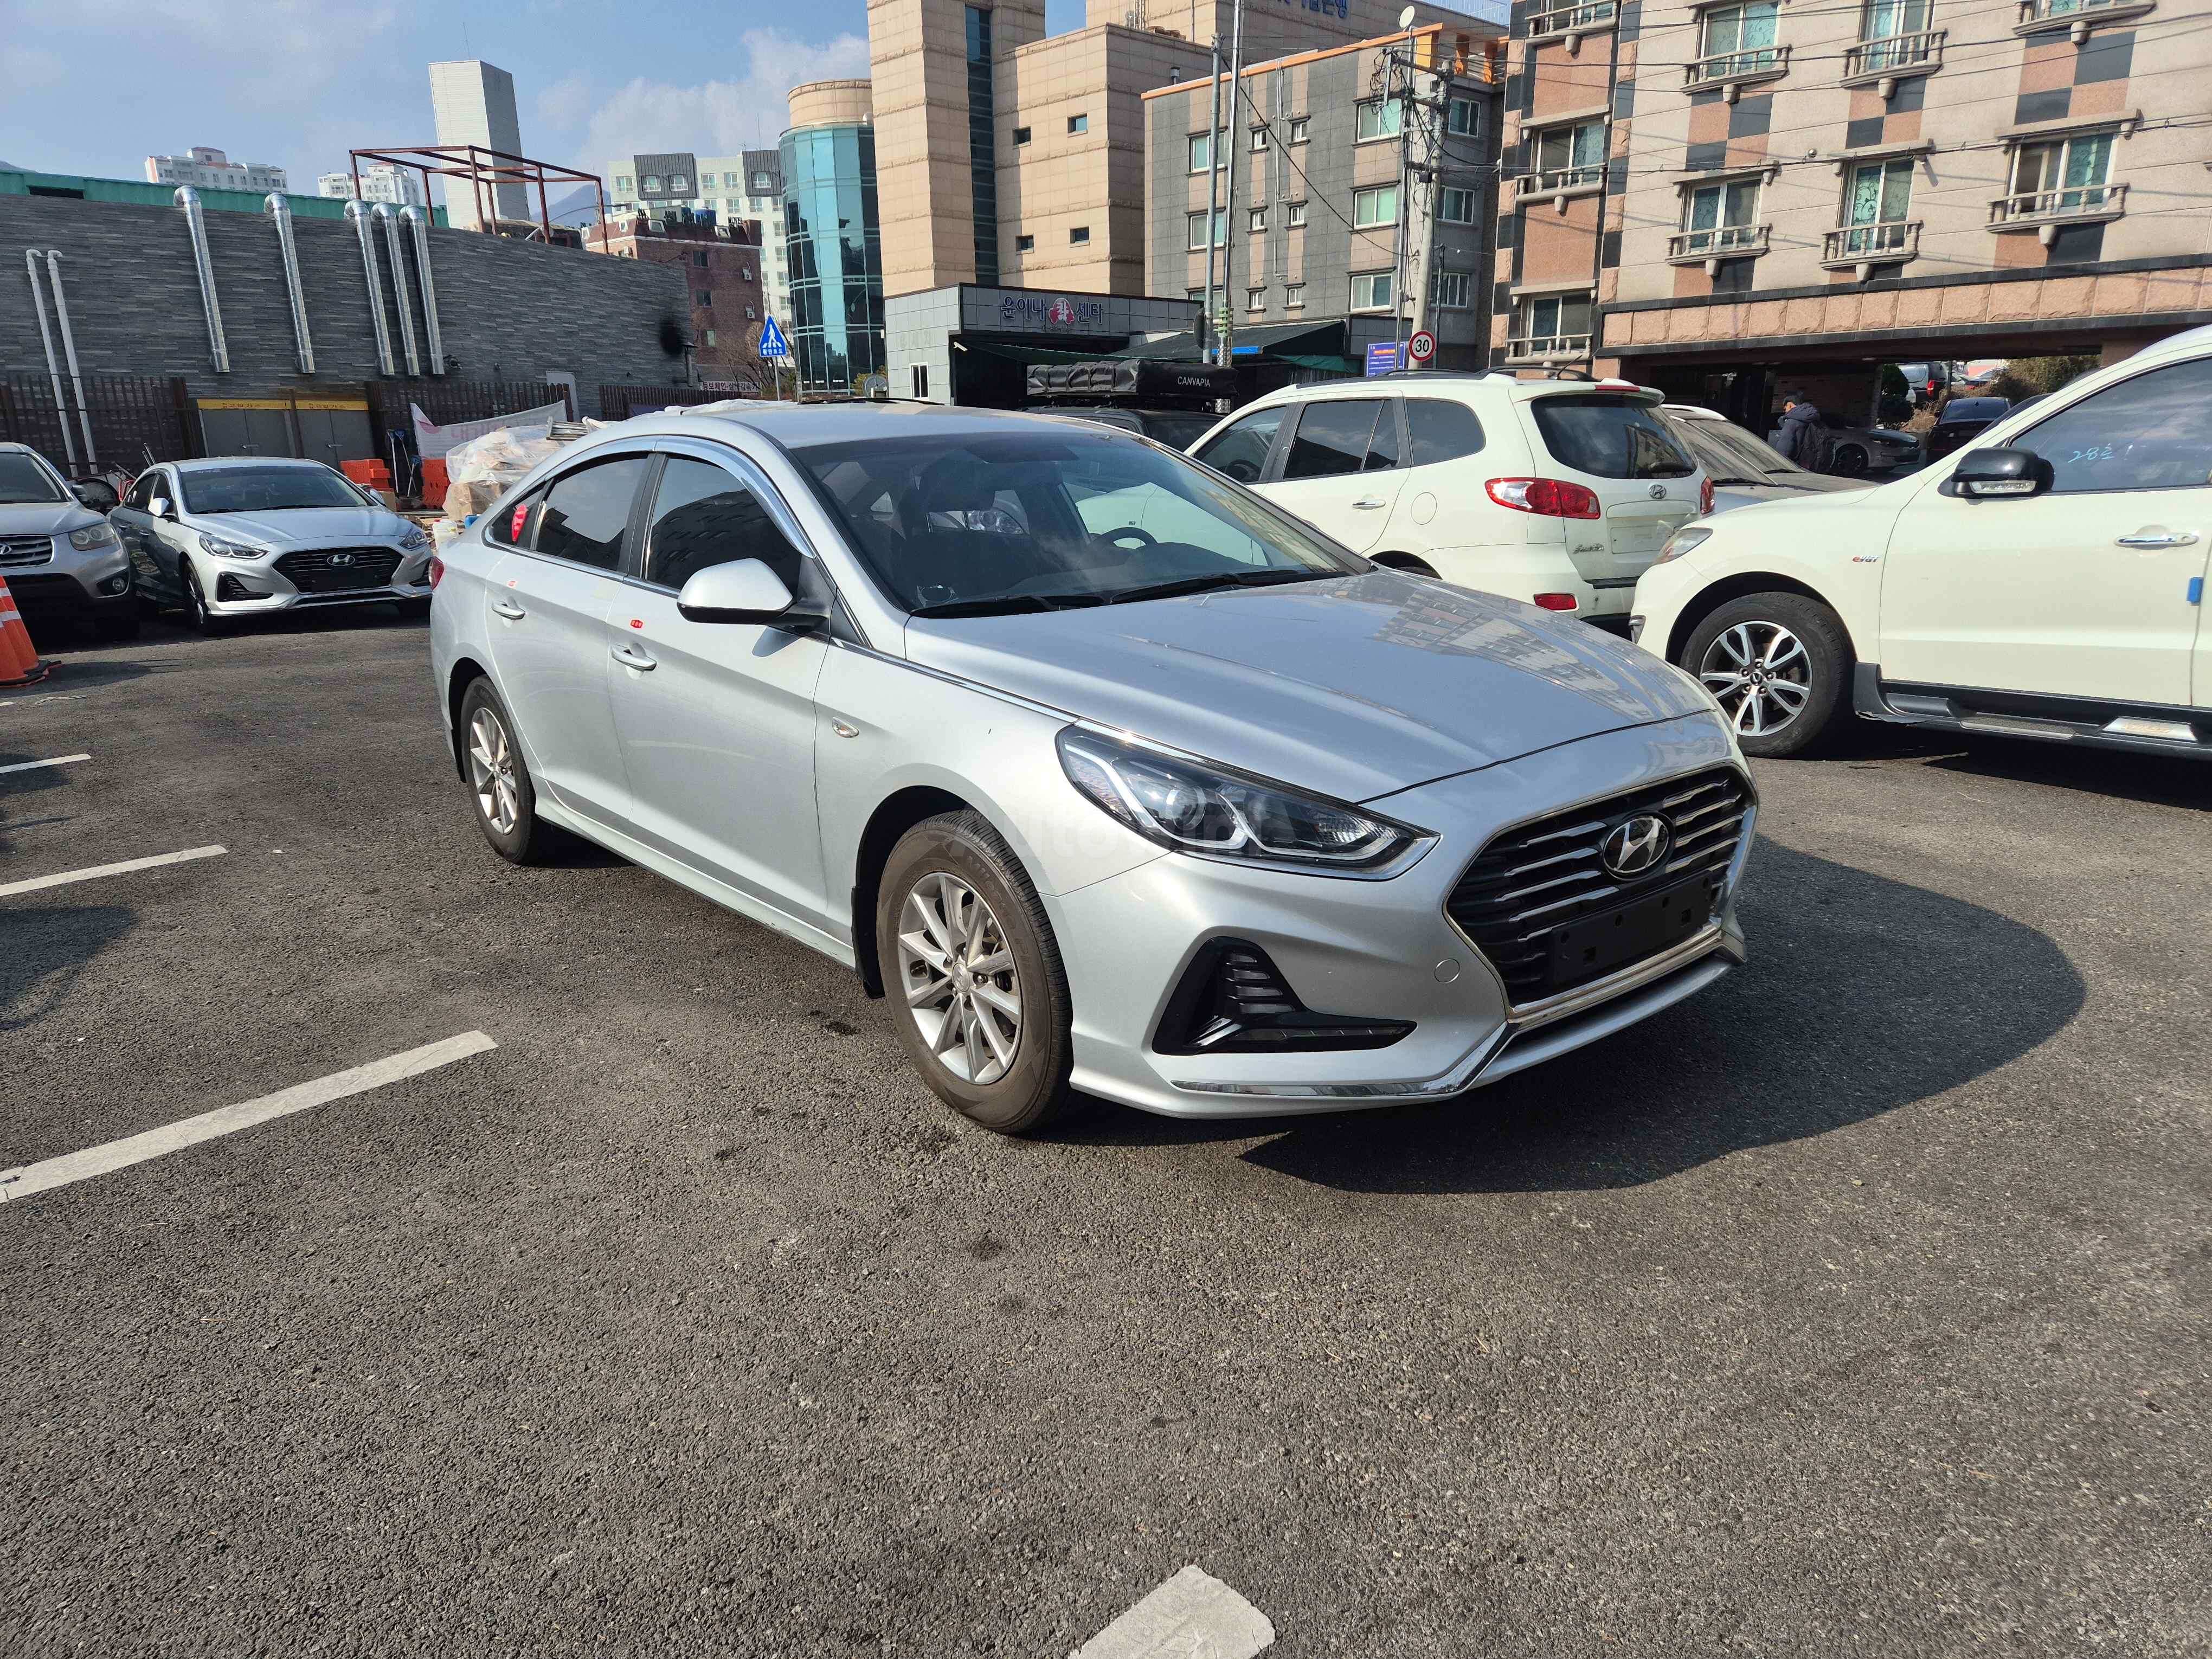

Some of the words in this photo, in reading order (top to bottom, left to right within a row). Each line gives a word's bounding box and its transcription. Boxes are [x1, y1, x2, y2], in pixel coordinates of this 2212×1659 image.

[1002, 296, 1046, 321] 윤이나
[1076, 301, 1103, 324] 센타
[1415, 339, 1430, 352] 30
[1177, 376, 1211, 387] CANVAPIA
